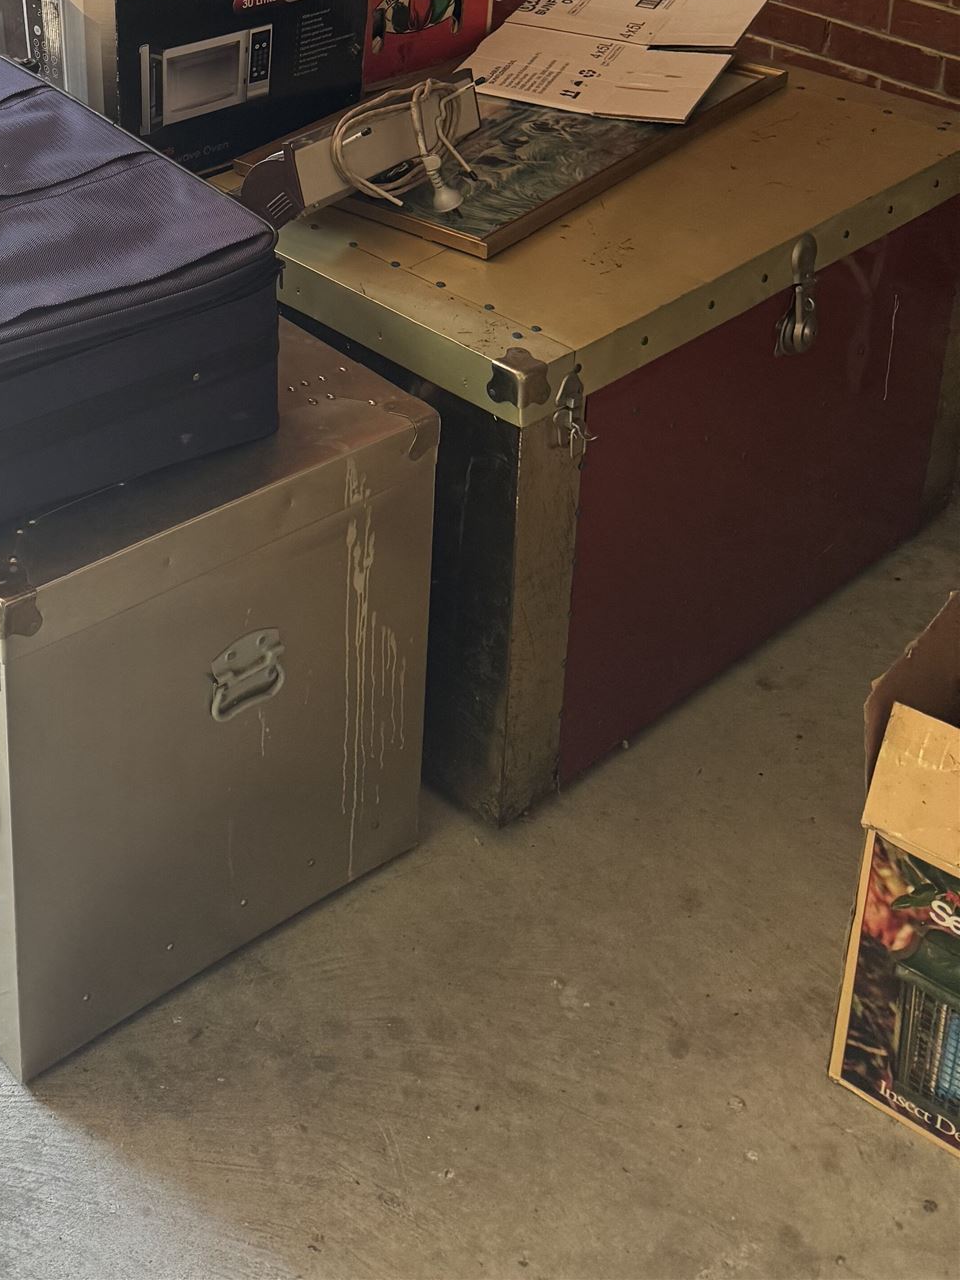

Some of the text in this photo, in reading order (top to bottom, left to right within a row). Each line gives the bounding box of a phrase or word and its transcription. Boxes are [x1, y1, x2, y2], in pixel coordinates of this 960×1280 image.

[619, 22, 646, 39] 4x5L
[590, 43, 614, 59] 4x5L
[880, 1080, 932, 1125] Insect
